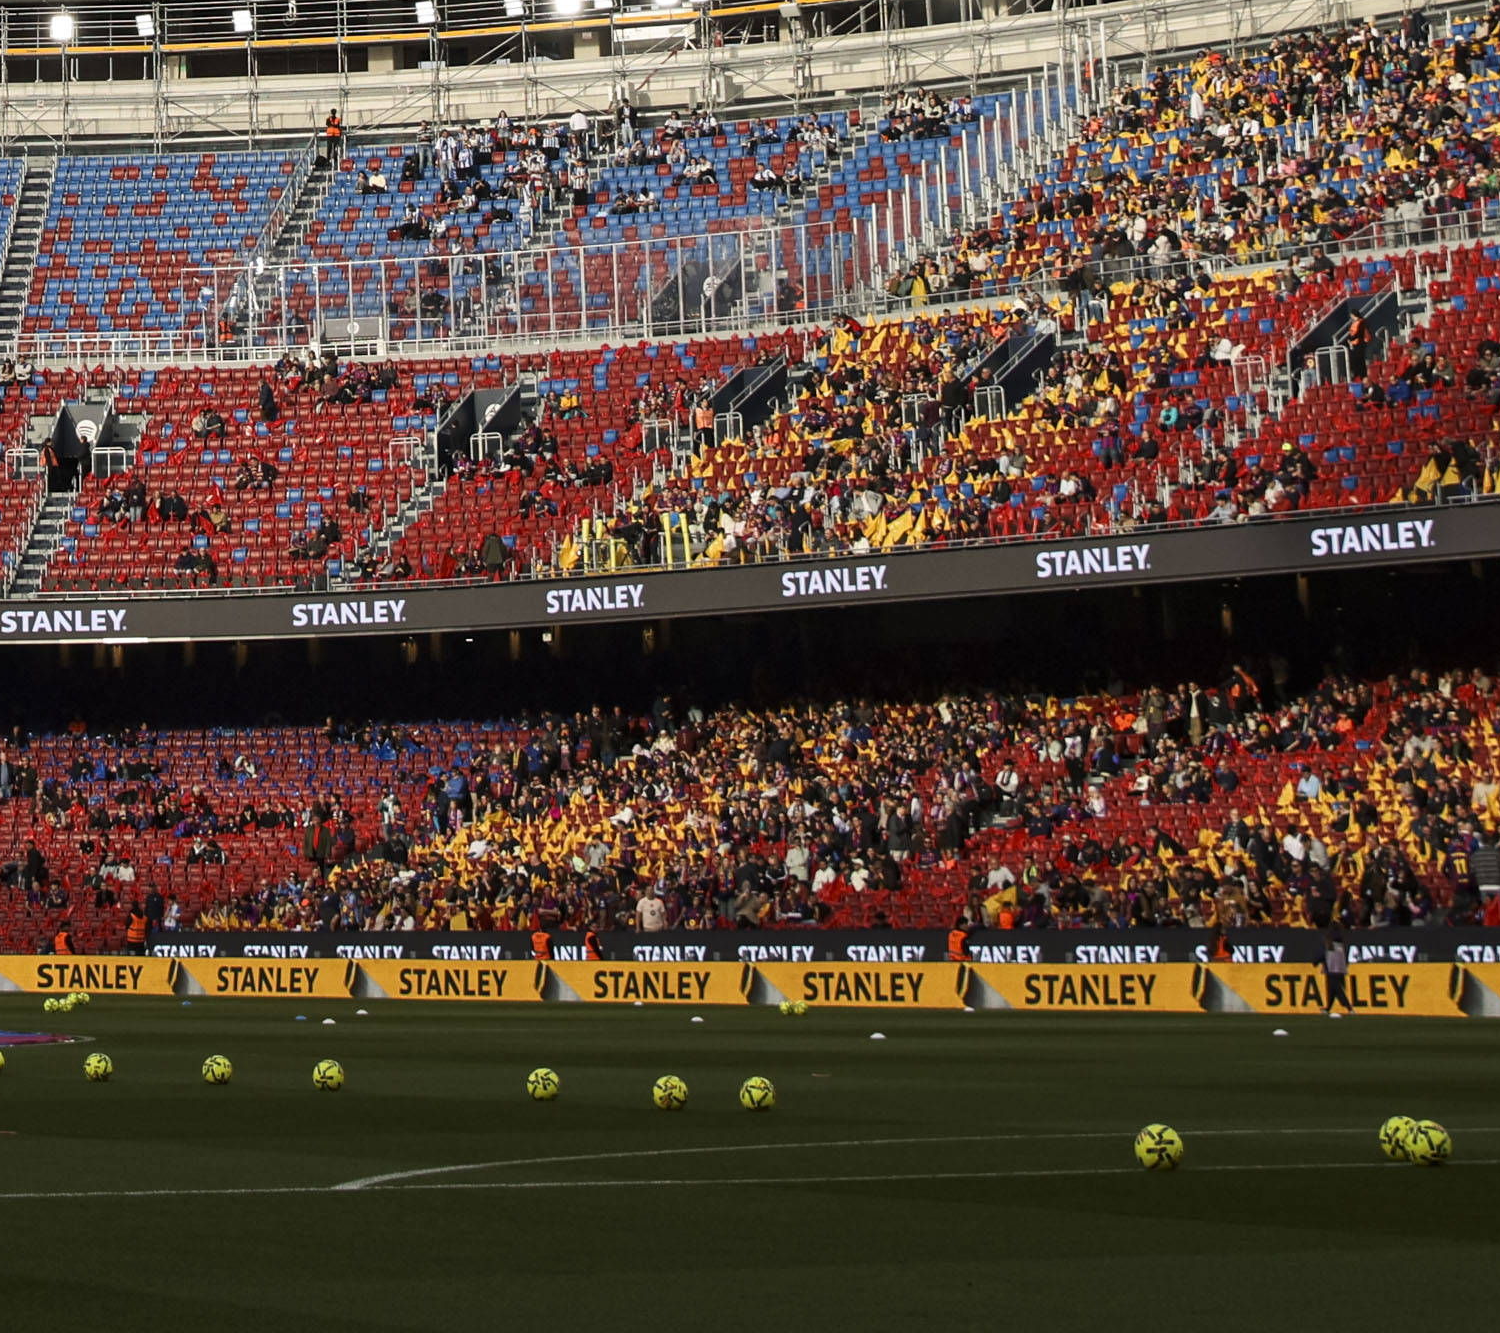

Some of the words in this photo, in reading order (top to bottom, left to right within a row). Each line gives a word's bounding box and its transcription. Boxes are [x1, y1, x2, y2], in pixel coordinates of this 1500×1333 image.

[969, 945, 1041, 964] TANLEY
[1195, 945, 1284, 963] SNLEY
[37, 963, 143, 990] STANLEY
[217, 966, 319, 993] STANLEY
[399, 968, 507, 996] STANLEY
[593, 970, 711, 1002] STANLEY
[803, 971, 924, 1003] STANLEY
[1025, 974, 1156, 1006] STANLEY
[1265, 973, 1410, 1008] STALEY
